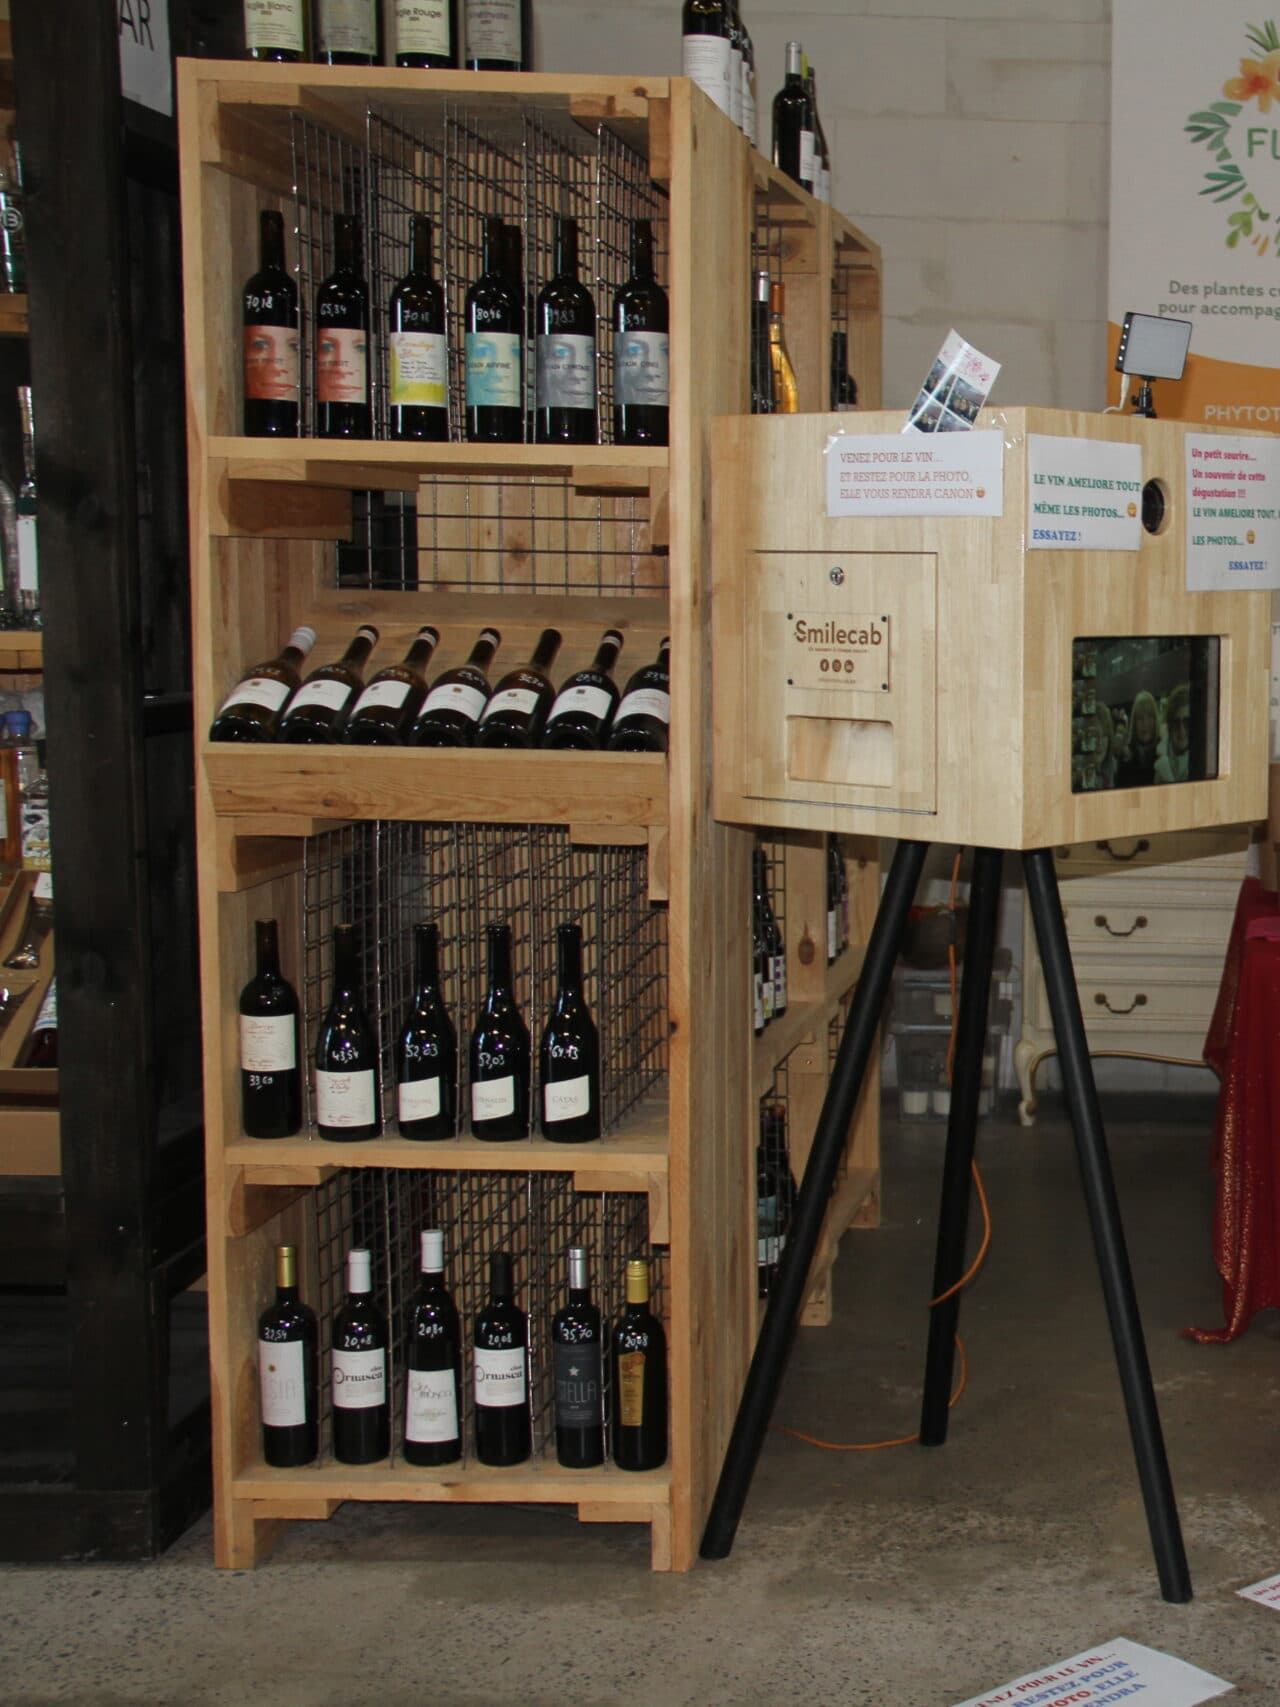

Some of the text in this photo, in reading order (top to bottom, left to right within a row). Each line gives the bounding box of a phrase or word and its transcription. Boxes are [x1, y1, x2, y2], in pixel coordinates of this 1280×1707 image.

[119, 0, 154, 52] AR
[1169, 280, 1198, 294] Des
[1203, 282, 1264, 299] plantes
[1159, 303, 1196, 316] pour
[840, 453, 871, 463] VENEZ
[873, 452, 898, 463] POUR
[901, 452, 913, 463] LE
[1192, 449, 1201, 458] Un
[1204, 450, 1222, 460] petit
[840, 472, 851, 482] ET
[853, 472, 887, 482] RESTEZ
[889, 472, 915, 482] POUR
[918, 472, 930, 482] LA
[1192, 469, 1202, 478] Un
[1205, 471, 1236, 480] souvenir
[1237, 471, 1246, 480] de
[1034, 474, 1140, 492] LE VIN AMELIORE TOUT
[840, 488, 974, 499] ELLE VOUS RENDRA CANON
[1034, 501, 1061, 515] MÊME
[1063, 505, 1080, 516] LES
[1193, 508, 1201, 517] LE
[1203, 508, 1216, 517] VIN
[1219, 508, 1254, 518] AMELIORE
[1192, 536, 1204, 545] LES
[795, 620, 882, 645] Smilecab
[1012, 1660, 1129, 1707] RESTEZ POUR
[1016, 1674, 1058, 1692] POUR
[1058, 1667, 1077, 1680] LE
[1095, 1670, 1139, 1690] ELLE
